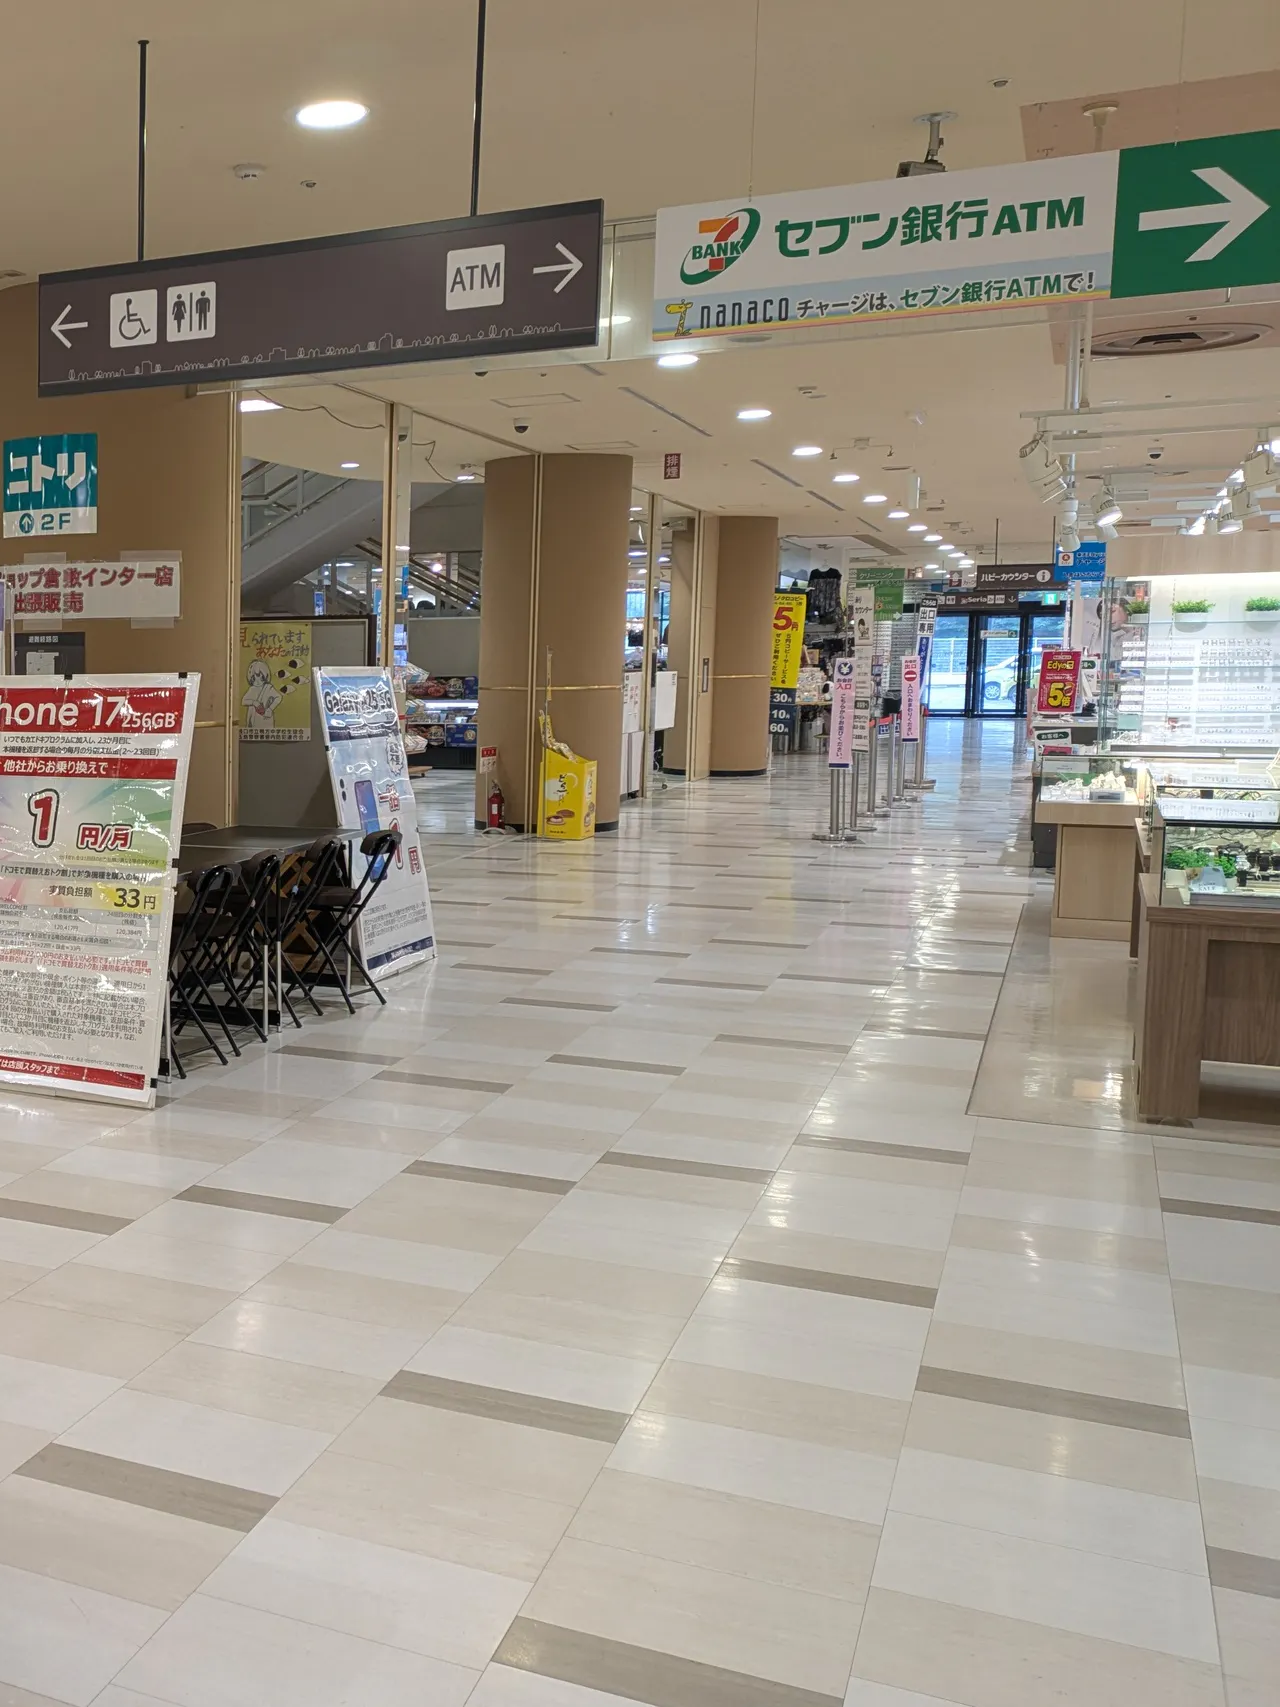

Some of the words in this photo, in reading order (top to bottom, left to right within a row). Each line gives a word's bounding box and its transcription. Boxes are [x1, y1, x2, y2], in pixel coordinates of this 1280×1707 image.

[775, 196, 1085, 258] セブン銀行ATM
[691, 239, 745, 261] BANK
[450, 261, 501, 293] ATM
[700, 297, 790, 329] nanaco
[7, 452, 86, 495] ニトリ
[666, 454, 679, 477] 排煙
[41, 513, 71, 530] 2F
[14, 591, 83, 614] 出張販売
[920, 608, 934, 620] 出口
[92, 696, 128, 726] 17
[121, 712, 177, 729] 256GB
[3, 759, 108, 775] 他社からお乗り換えで
[29, 789, 60, 847] 1
